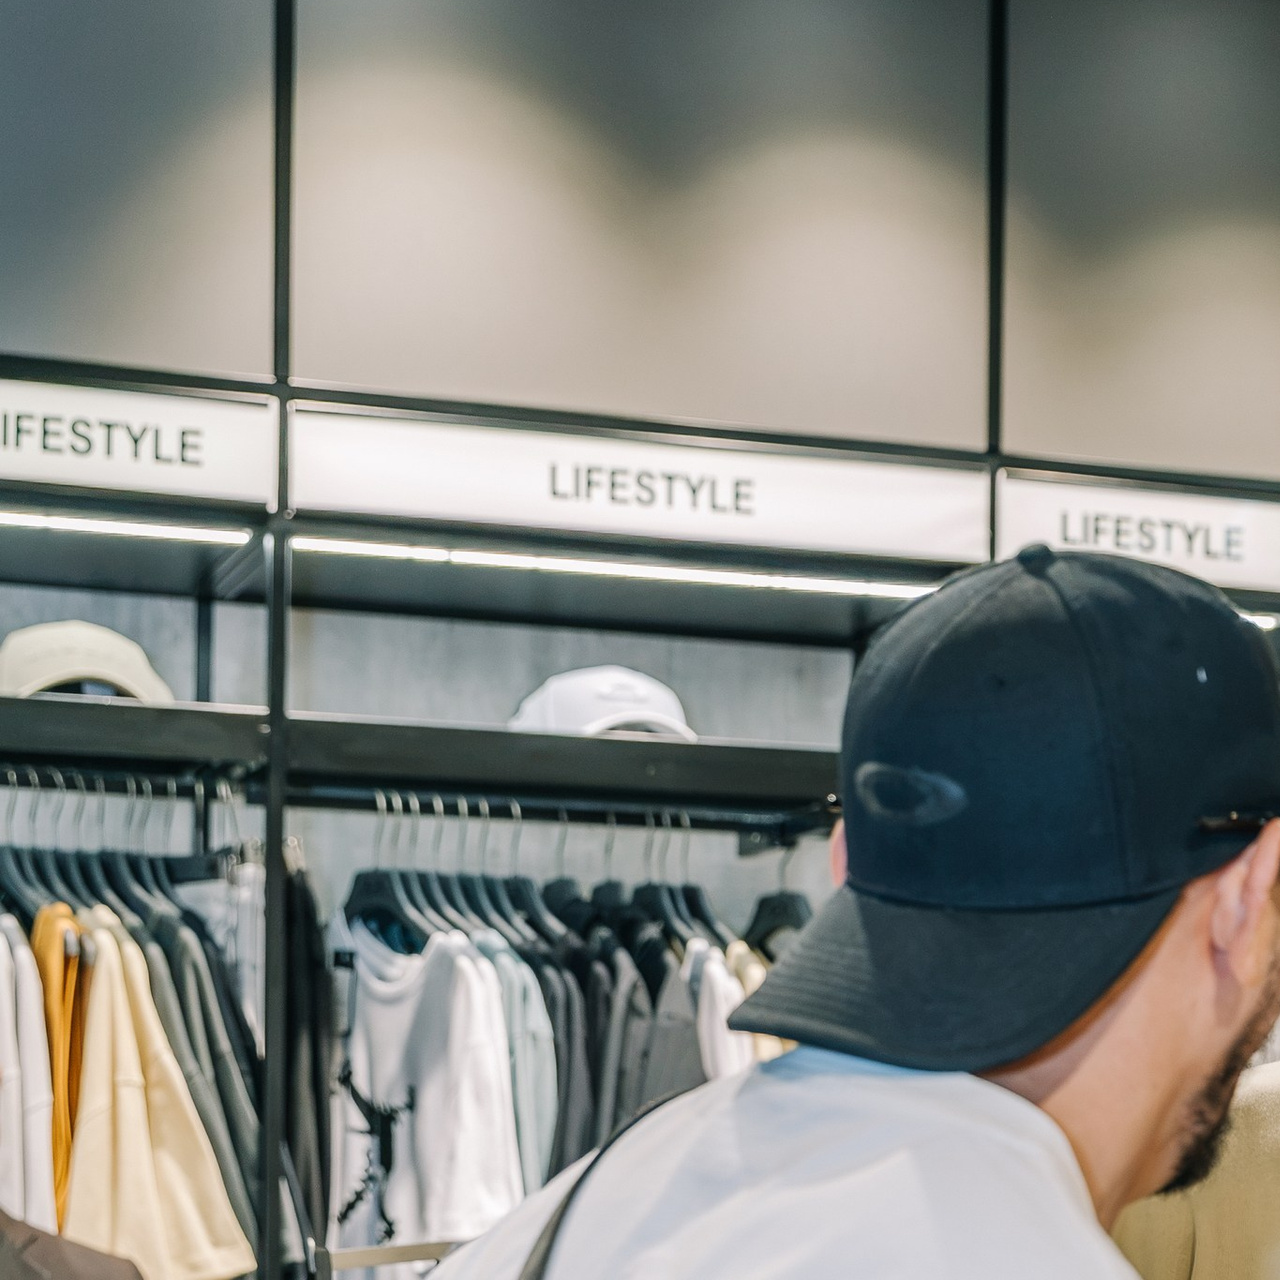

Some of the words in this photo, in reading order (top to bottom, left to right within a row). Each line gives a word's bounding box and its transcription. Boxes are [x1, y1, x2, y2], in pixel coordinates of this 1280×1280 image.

[2, 411, 204, 467] IFESTYLE
[549, 463, 756, 515] LIFESTYLE
[1061, 510, 1244, 561] LIFESTYLE
